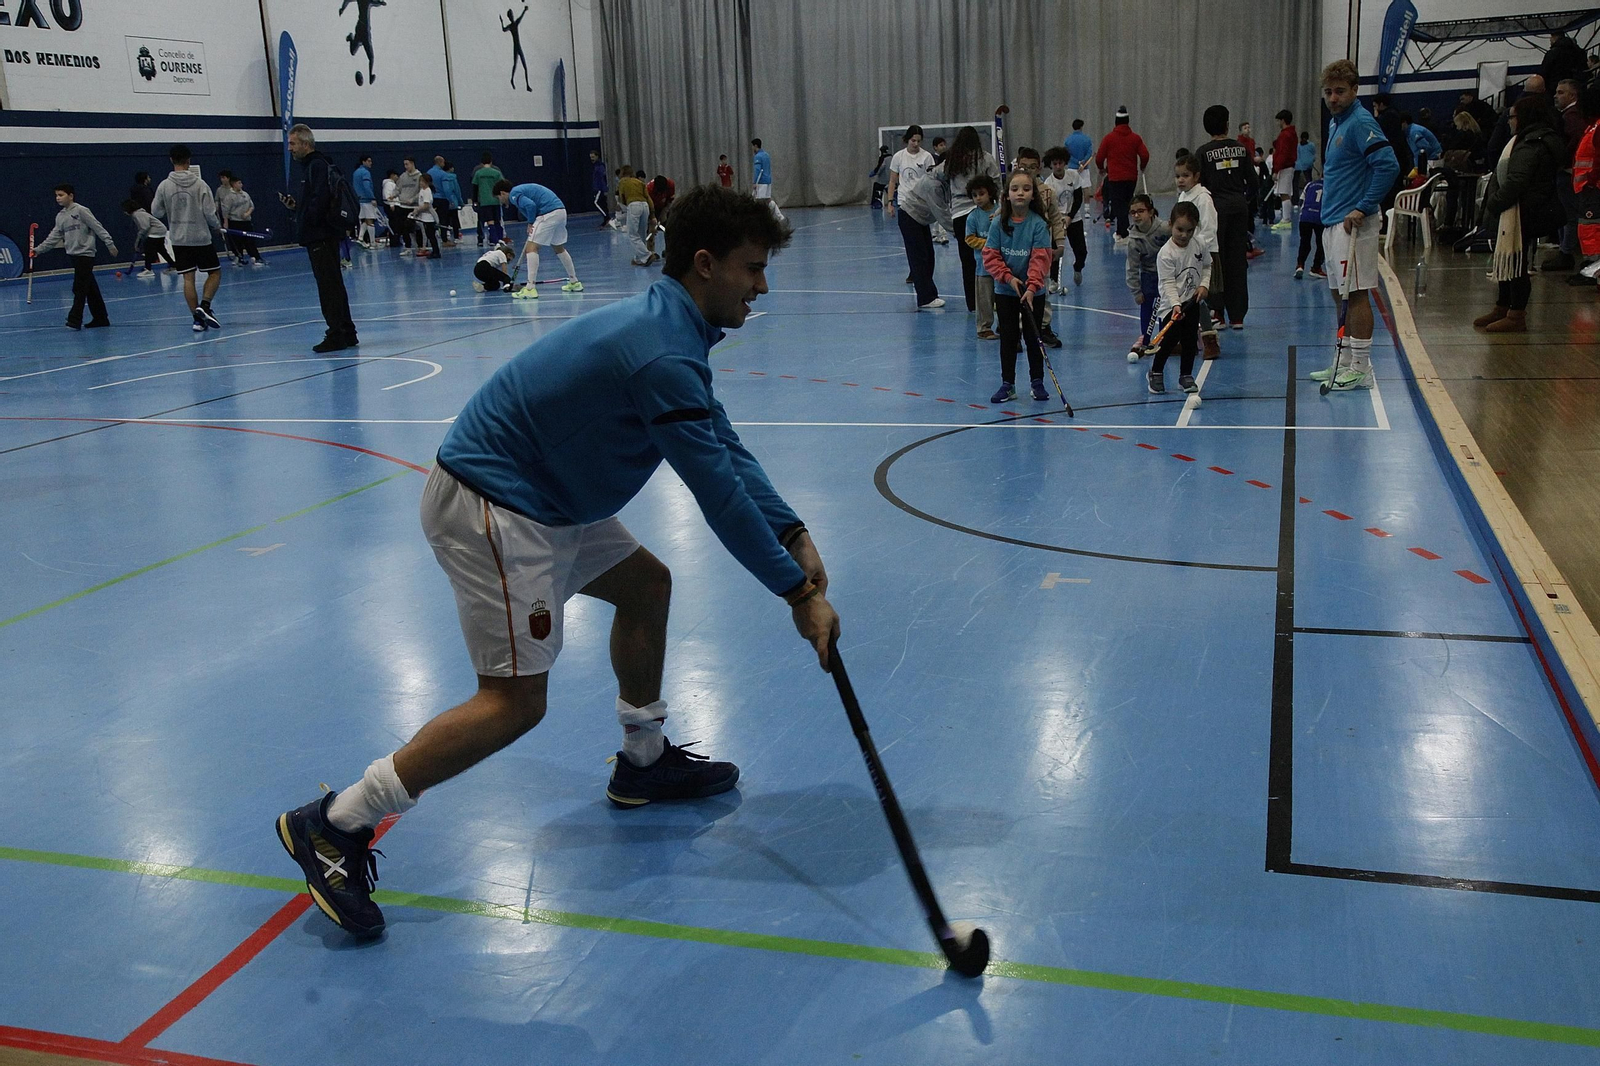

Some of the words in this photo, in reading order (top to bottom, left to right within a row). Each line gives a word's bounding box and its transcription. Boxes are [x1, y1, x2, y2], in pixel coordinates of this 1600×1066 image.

[1386, 10, 1413, 76] Sabadell
[4, 49, 31, 64] DOS
[36, 52, 101, 69] REMEDIOS
[158, 48, 185, 59] Concello
[187, 52, 195, 60] de
[160, 61, 203, 74] OURENSE
[1340, 260, 1348, 277] 7
